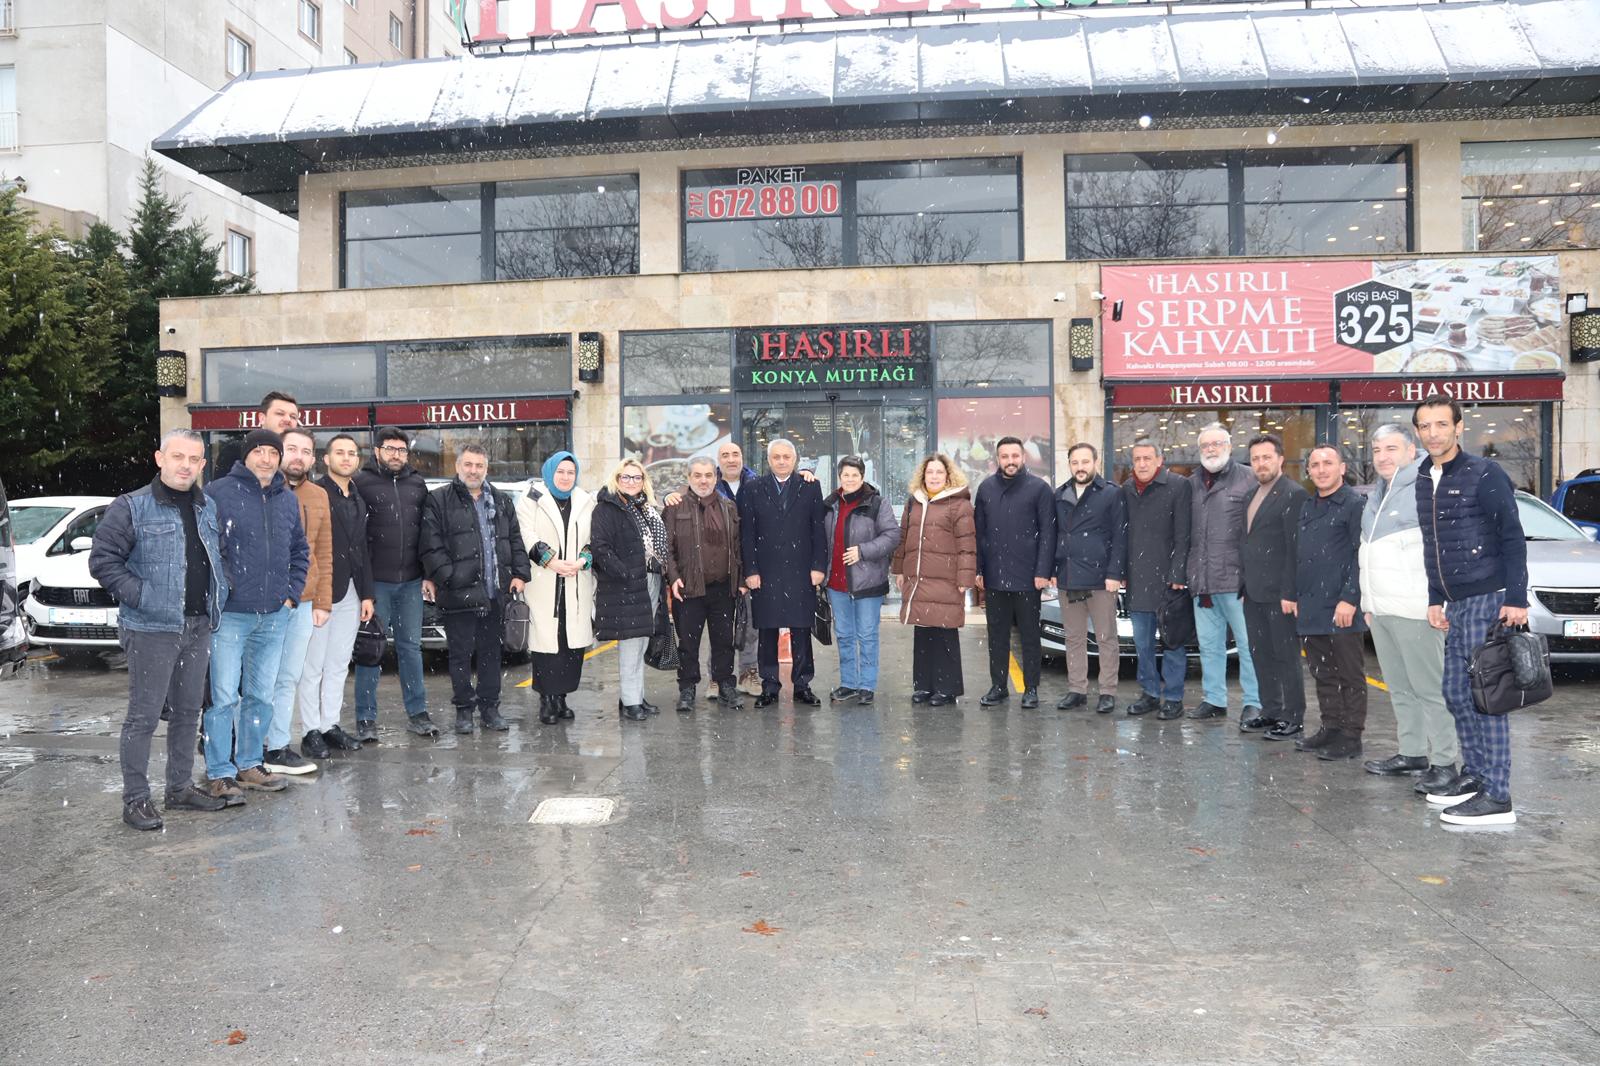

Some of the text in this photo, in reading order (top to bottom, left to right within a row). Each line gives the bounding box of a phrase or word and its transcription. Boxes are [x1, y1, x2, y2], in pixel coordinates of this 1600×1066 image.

[738, 167, 806, 185] PAKET
[688, 183, 839, 219] 212 672 88 00
[1156, 271, 1289, 295] HASIRLI
[1137, 297, 1303, 328] SERPME
[760, 328, 913, 361] HASIRLI
[1122, 327, 1319, 358] KAHVALTI
[751, 365, 915, 385] KONYA MUTFAĞI
[1174, 384, 1273, 404] HASIRLI
[430, 402, 518, 423] HASIRLI
[73, 588, 90, 603] FIAT
